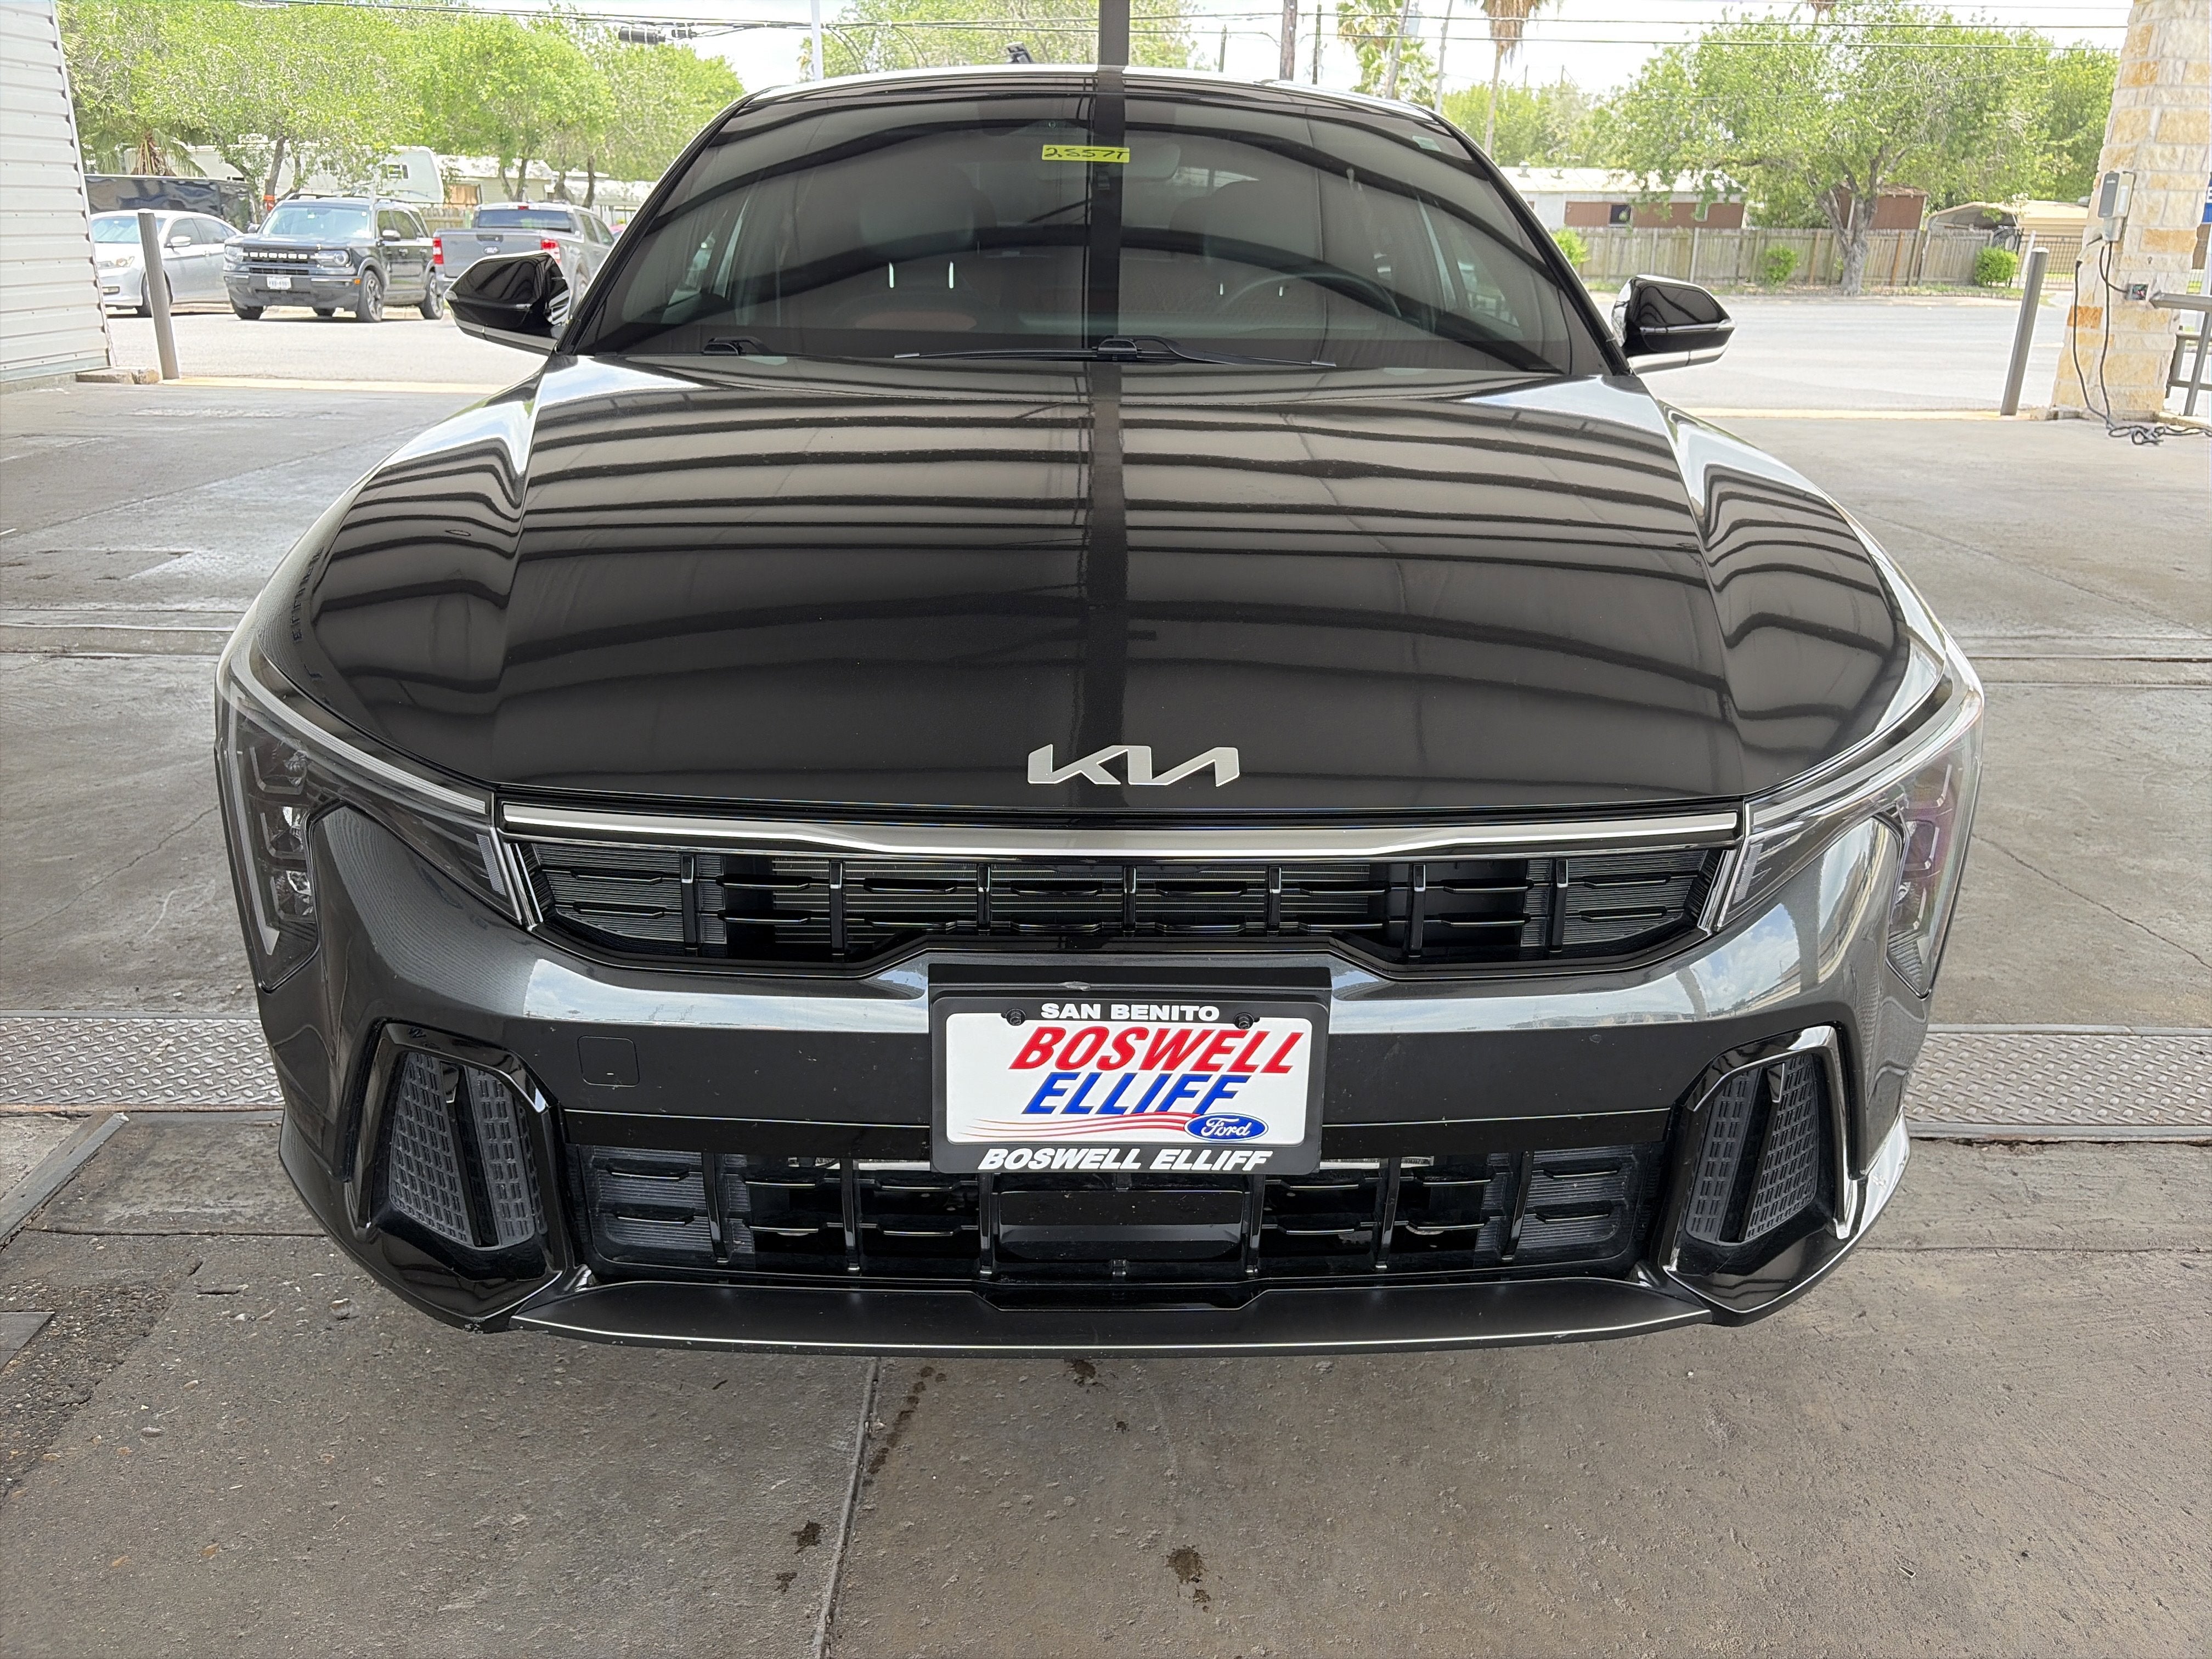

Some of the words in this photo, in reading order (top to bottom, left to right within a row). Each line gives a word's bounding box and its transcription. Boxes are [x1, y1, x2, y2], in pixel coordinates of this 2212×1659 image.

[1028, 744, 1240, 787] KIA
[1041, 1003, 1101, 1019] SAN
[1110, 1005, 1220, 1021] BENITO
[1008, 1026, 1304, 1074] BOSWELL
[1021, 1071, 1251, 1115] ELLIFF
[1200, 1117, 1252, 1136] Ford
[978, 1148, 1142, 1170] BOSWELL
[1149, 1149, 1273, 1171] ELLIFF
